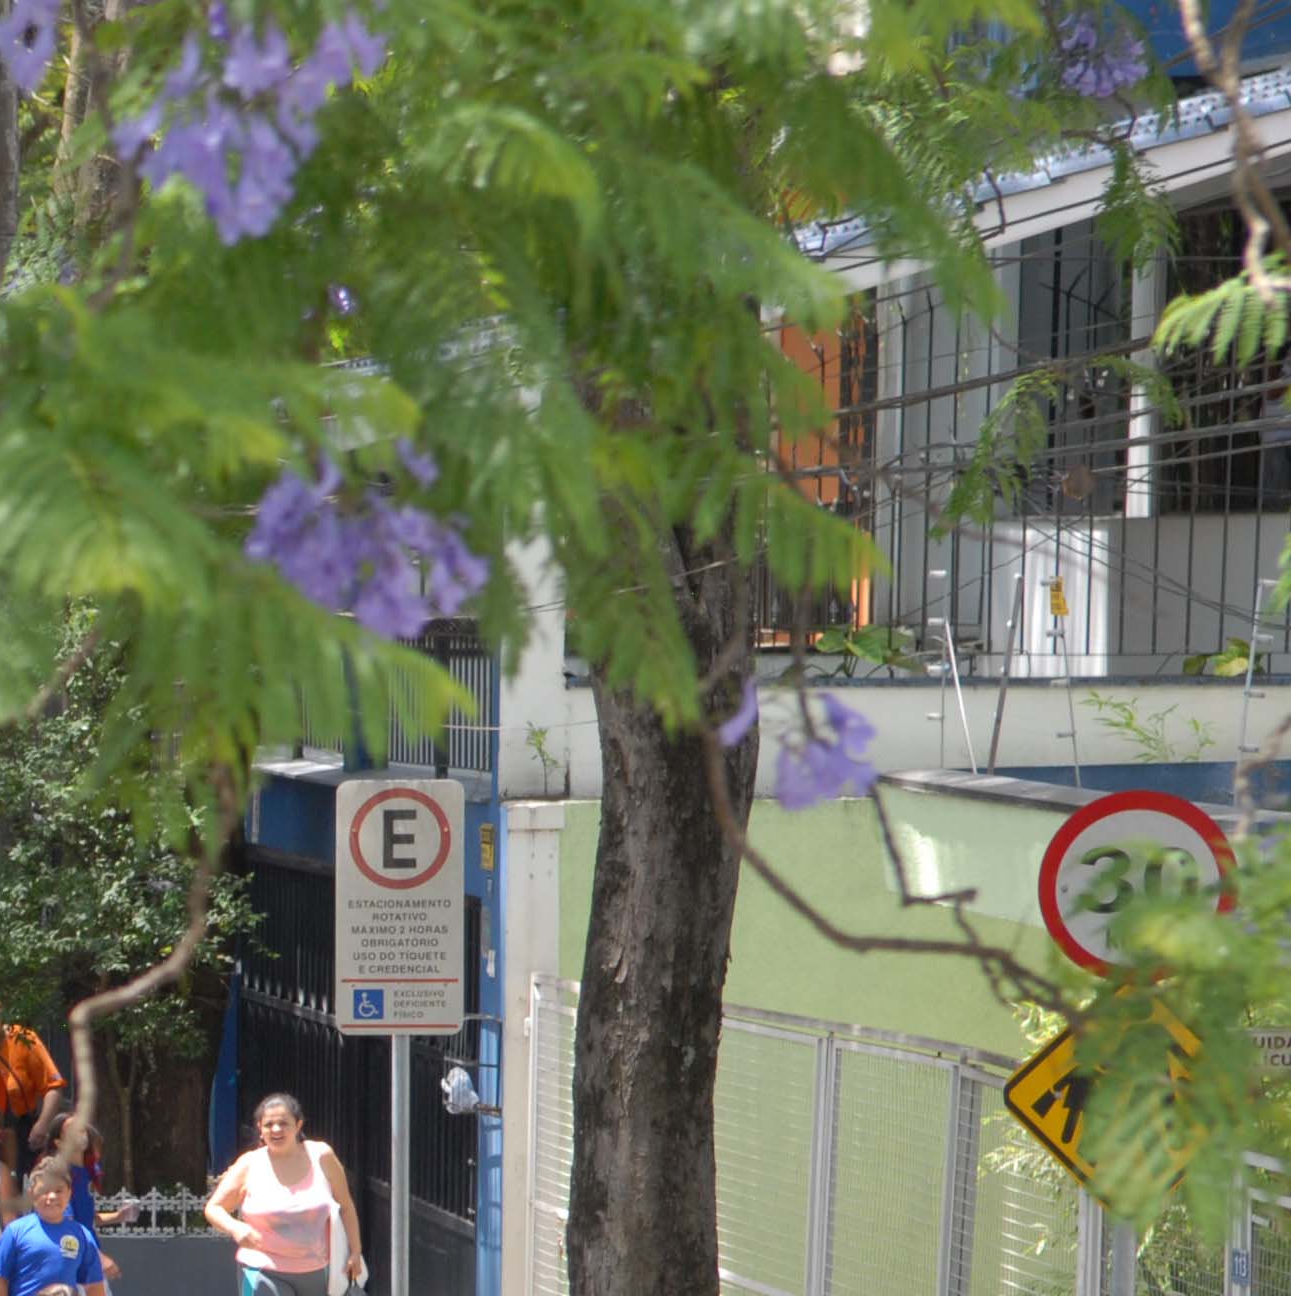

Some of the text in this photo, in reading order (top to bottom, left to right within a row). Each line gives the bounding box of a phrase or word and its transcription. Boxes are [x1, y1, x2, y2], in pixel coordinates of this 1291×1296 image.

[383, 809, 417, 869] E
[1080, 845, 1199, 914] 30
[348, 899, 452, 909] ESTACIONAMENTO
[372, 912, 428, 921] ROTATIVO
[400, 926, 405, 935] 2
[409, 925, 449, 935] HORAS
[353, 952, 376, 961] USO
[379, 952, 396, 961] DO
[359, 965, 441, 974] E CREDENCIAL
[394, 990, 445, 998] EXCLUSIVO
[394, 1000, 447, 1008] DEFICIENTE
